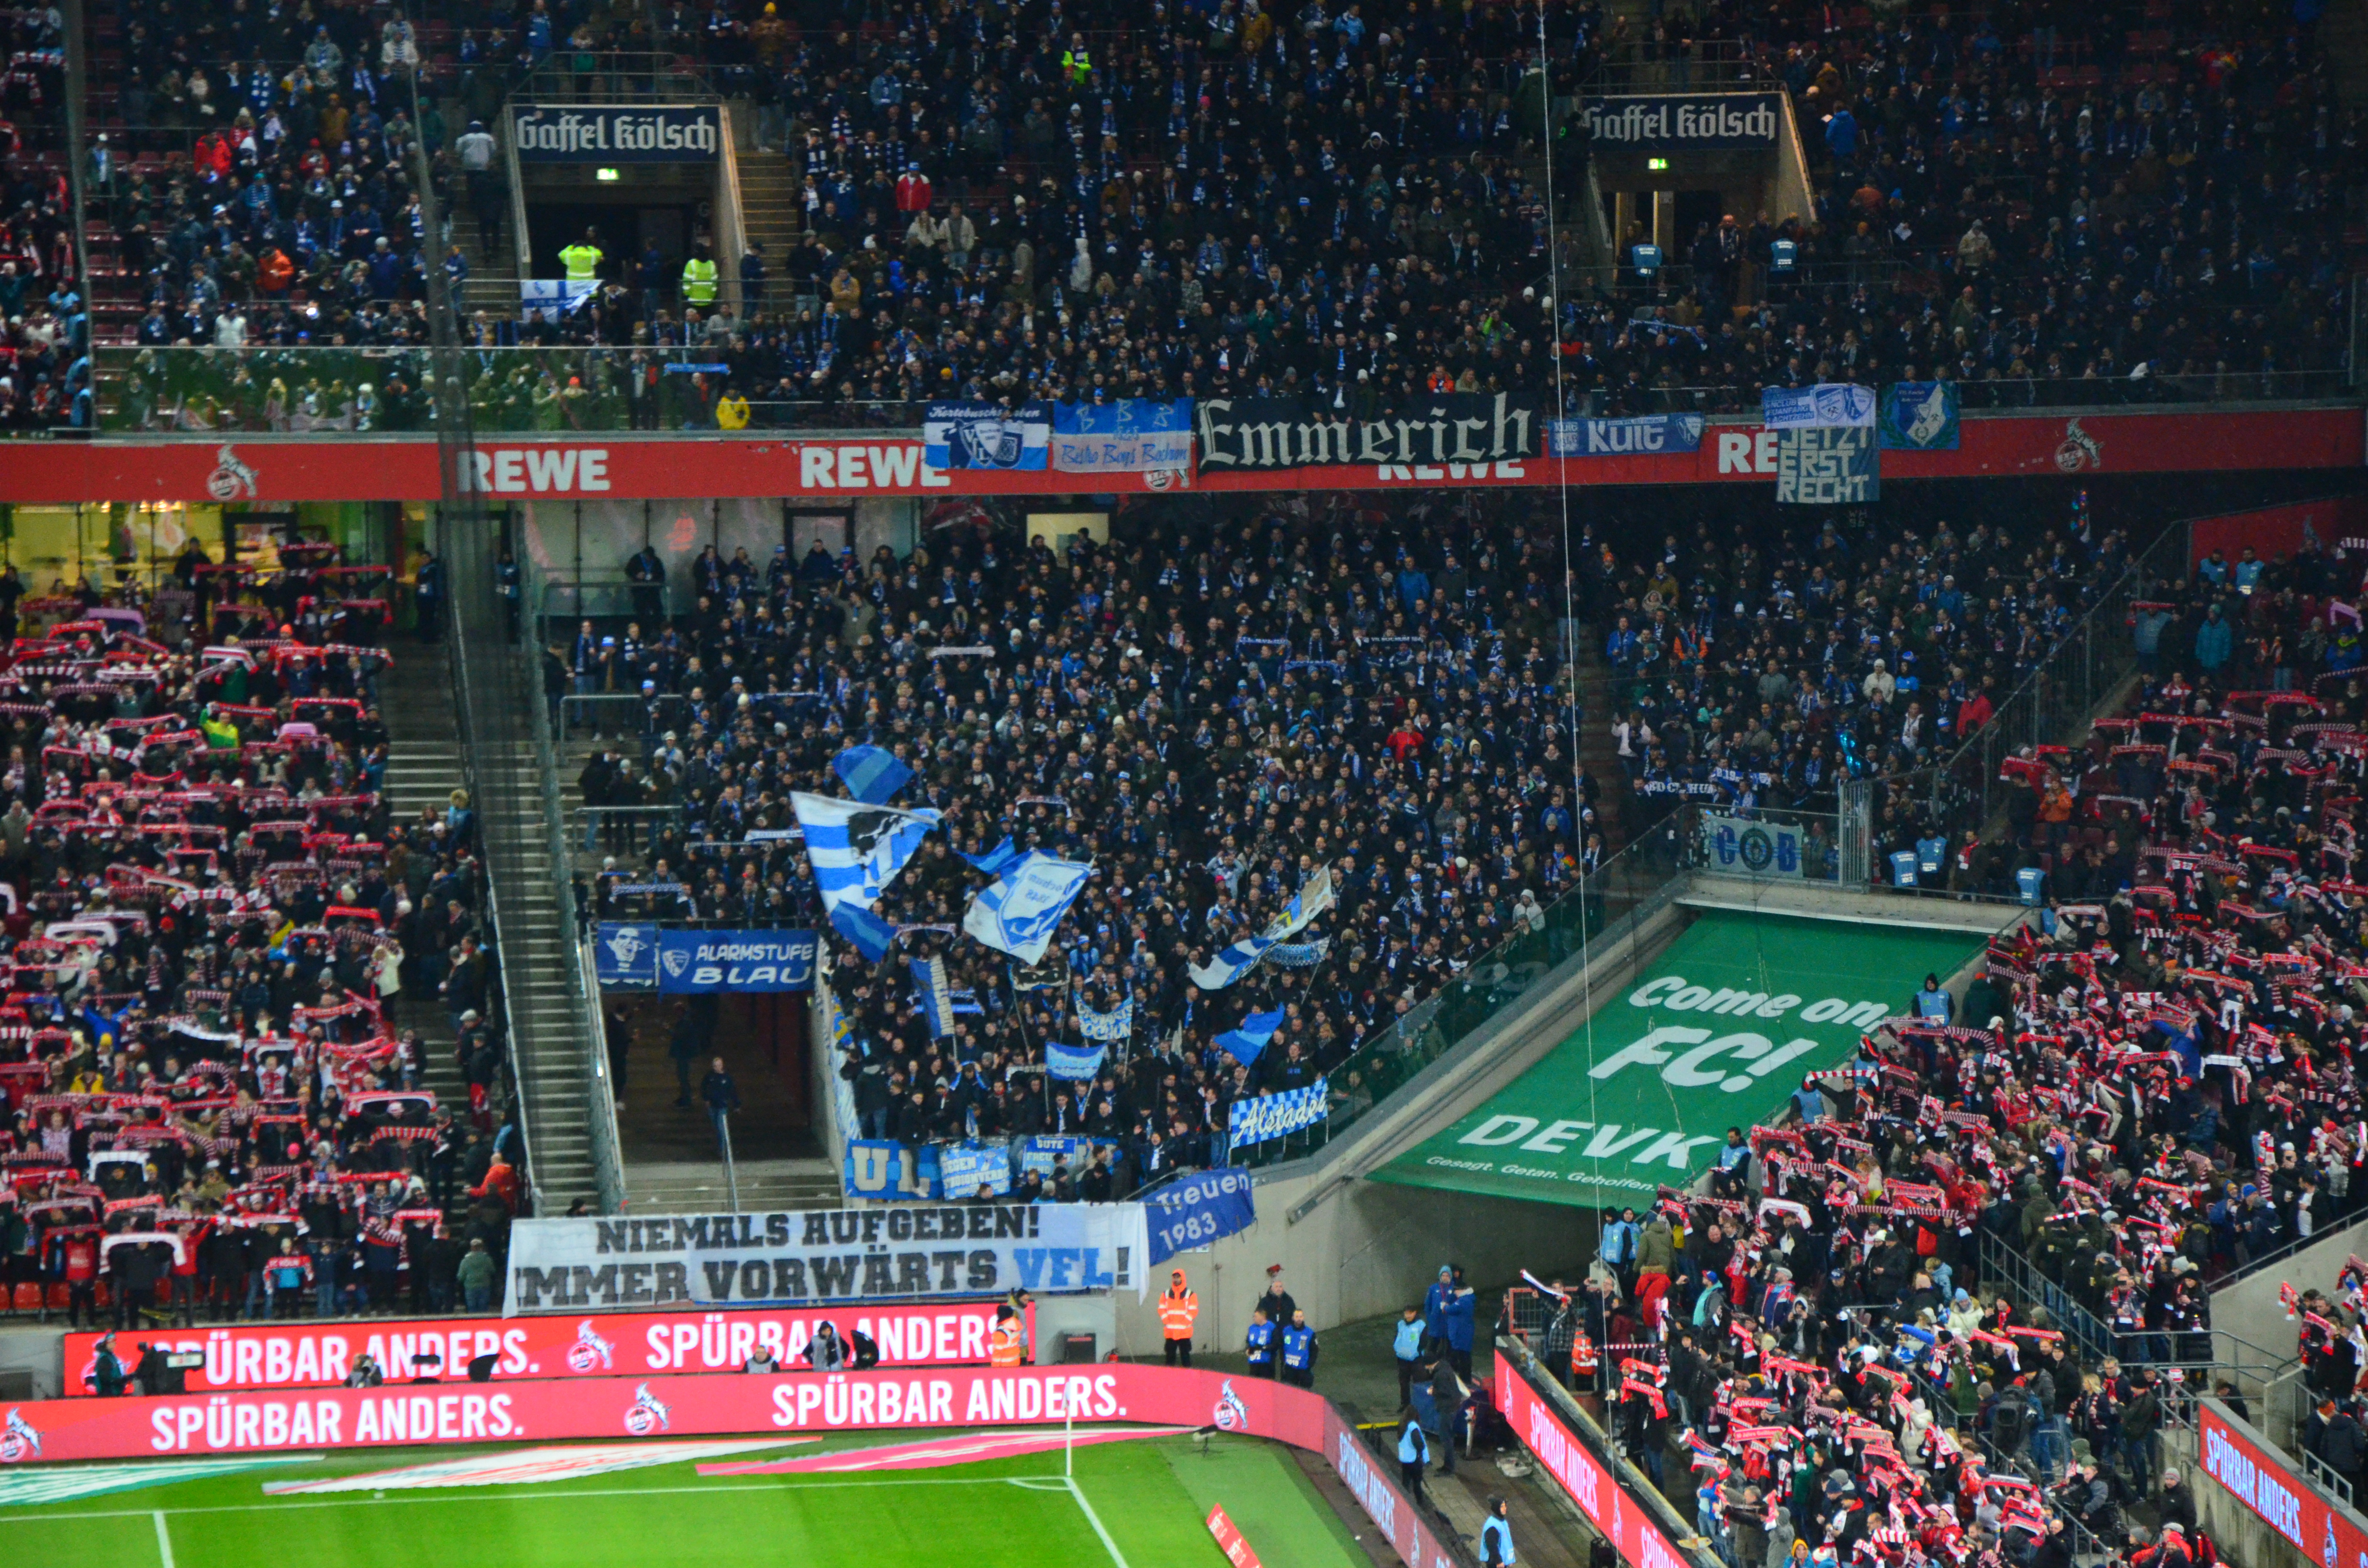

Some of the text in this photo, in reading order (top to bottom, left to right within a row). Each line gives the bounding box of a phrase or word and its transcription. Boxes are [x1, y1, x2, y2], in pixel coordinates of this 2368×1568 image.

[517, 115, 715, 155] Gaffel Kölsch
[1582, 103, 1776, 142] Gaffel Kölsch
[1197, 391, 1533, 468] Emmerich
[1780, 428, 1869, 450] JETZT
[457, 450, 610, 492] REWE
[1780, 450, 1855, 477] ERST
[1777, 474, 1869, 504] RECHT
[696, 943, 814, 962] ALARMSTUFE
[692, 966, 811, 984] BLAU
[1628, 976, 1802, 1018] Come
[1587, 1024, 1819, 1093] FC!
[1027, 1152, 1073, 1163] FREUE
[1457, 1114, 1721, 1170] DEVK
[1155, 1172, 1251, 1215] Treuen
[1426, 1156, 1655, 1192] Gesagt. Getan. Geholfen.
[597, 1205, 1040, 1254] NIEMALS AUFGEBEN!
[1159, 1212, 1219, 1251] 1983
[702, 1244, 998, 1299] VORWÄRTS
[772, 1375, 1127, 1427] SPÜRBAR ANDERS.
[151, 1394, 525, 1451] SPÜRBAR ANDERS.
[1529, 1401, 1601, 1519] SPÜRBAR ANDERS.
[1339, 1431, 1397, 1544] SPÜRBAR ANDERS.
[2207, 1428, 2304, 1549] SPÜRBAR ANDERS.
